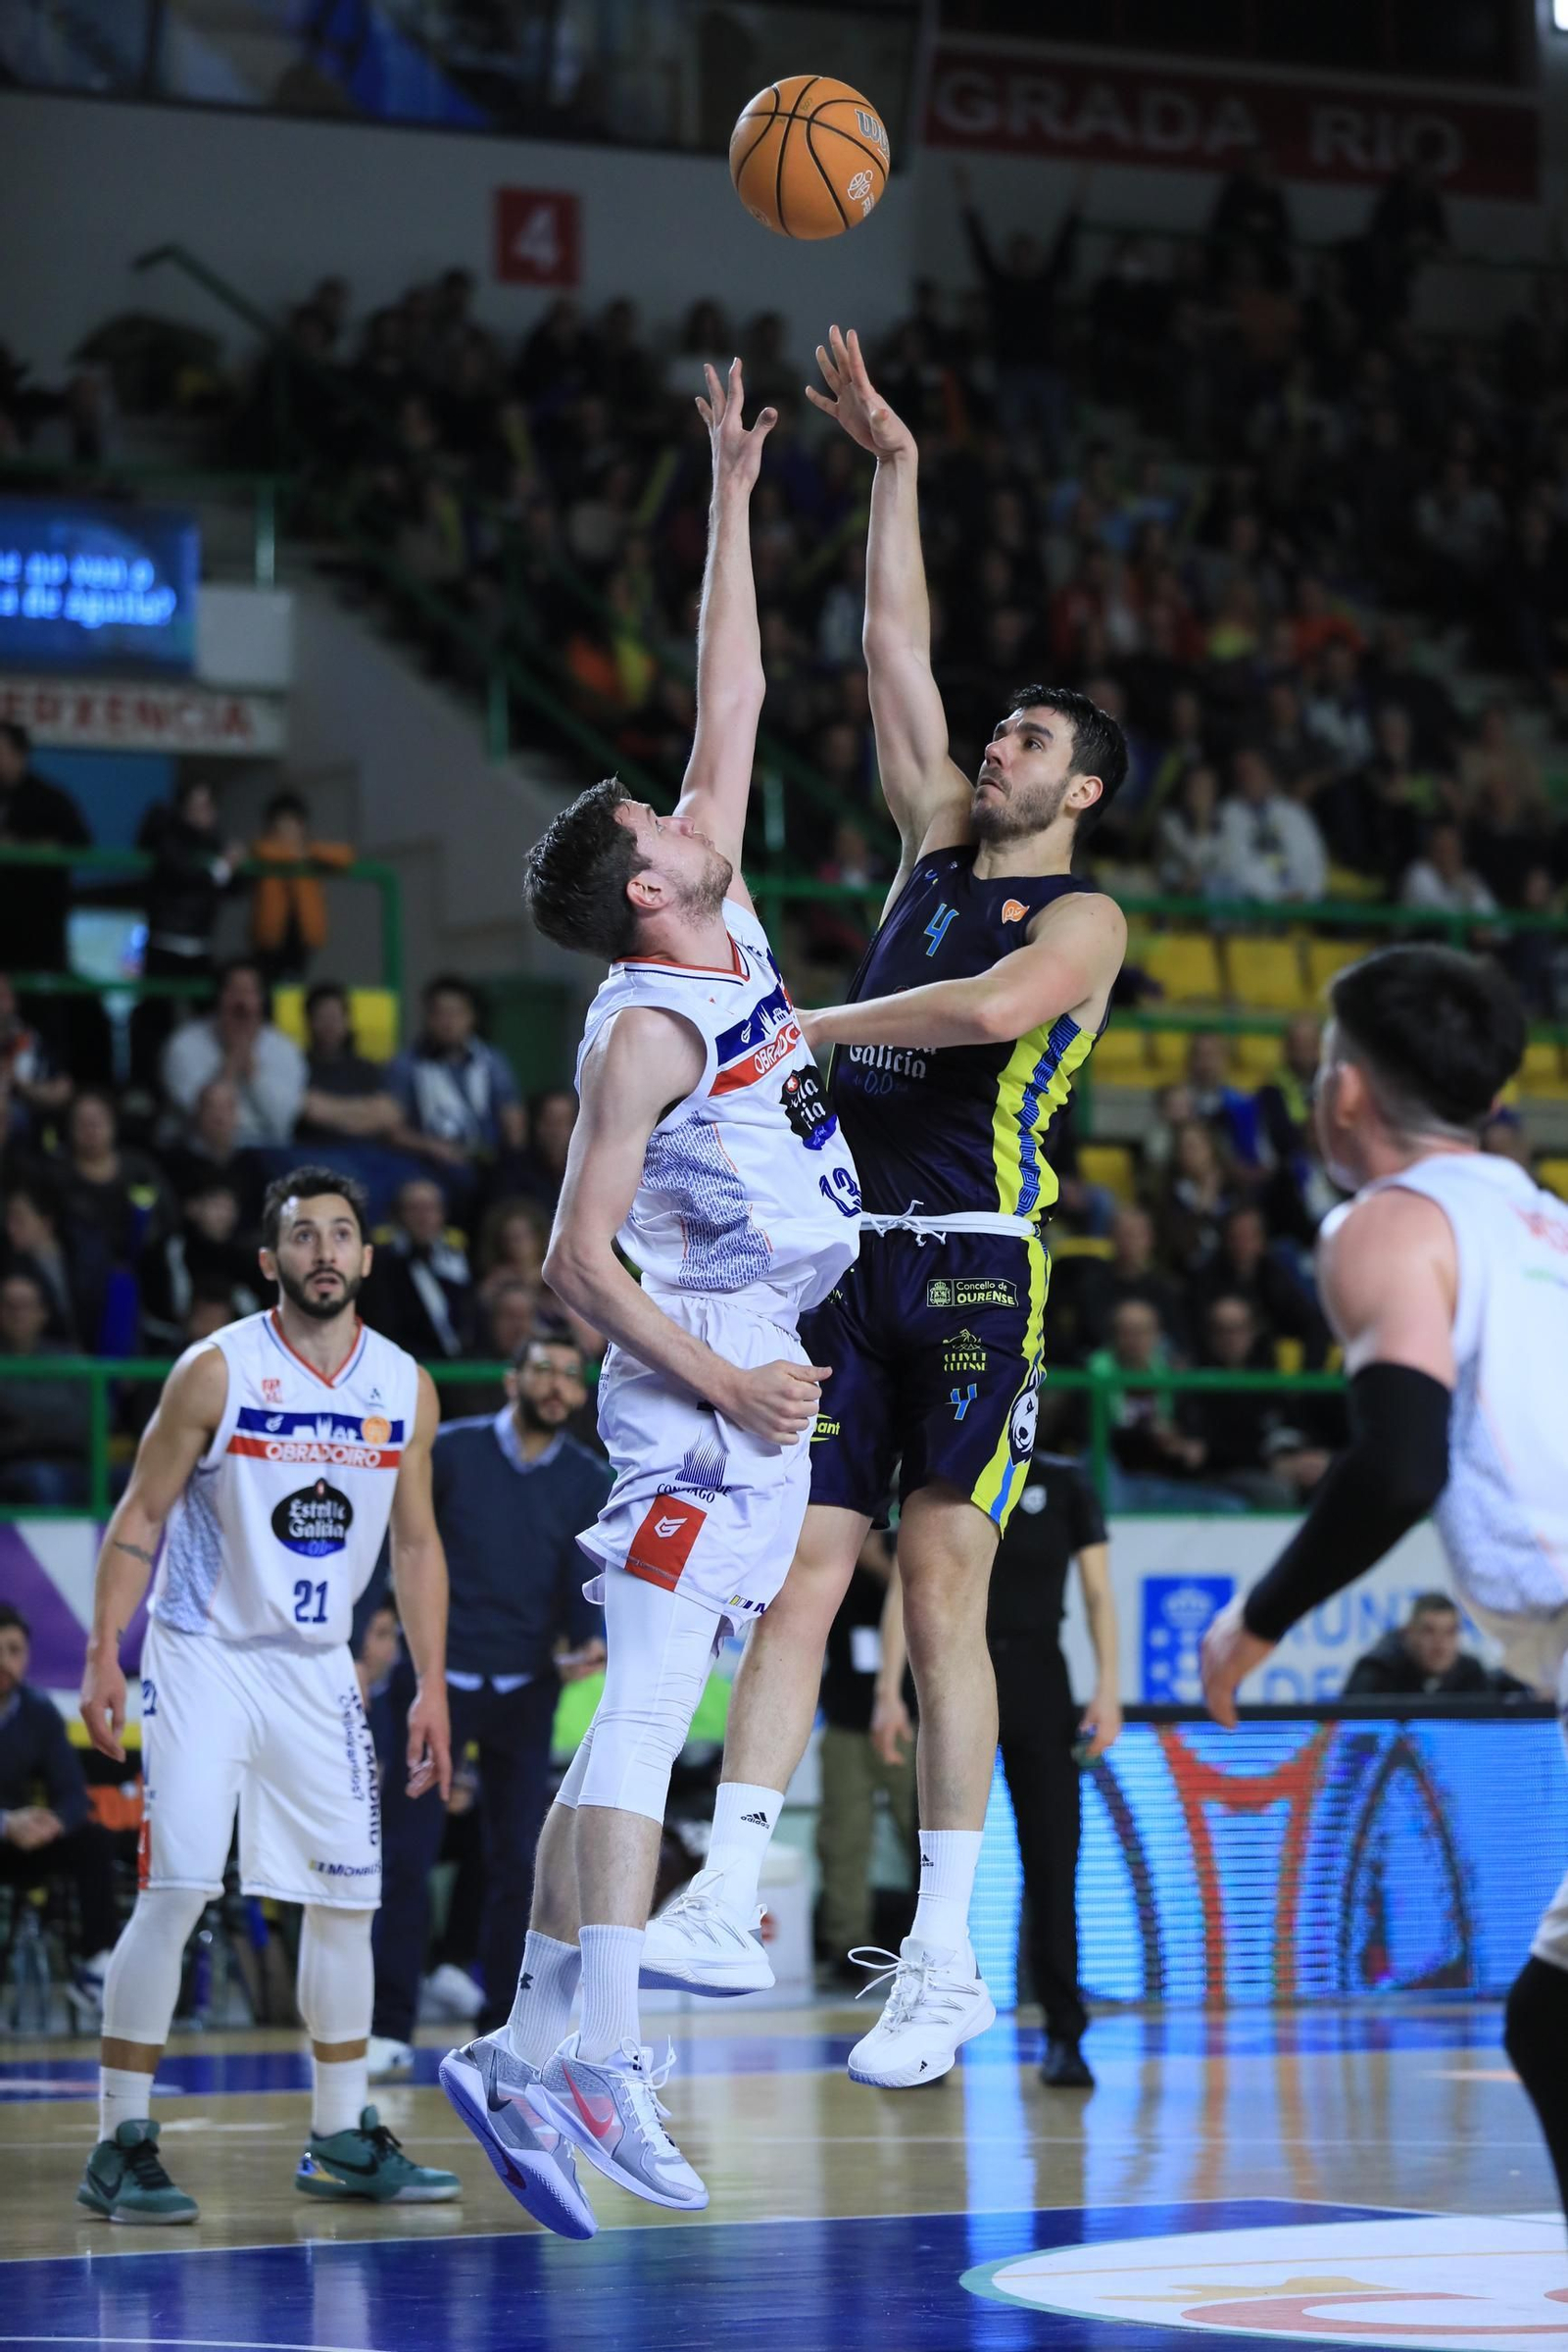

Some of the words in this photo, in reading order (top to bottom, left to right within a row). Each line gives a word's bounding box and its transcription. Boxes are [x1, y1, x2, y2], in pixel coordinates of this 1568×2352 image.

[933, 68, 1259, 155] GRADA
[1309, 105, 1463, 176] RIO
[514, 203, 559, 274] 4
[923, 903, 959, 957] 4
[849, 1044, 926, 1079] Galicia
[819, 1167, 862, 1217] 13
[956, 1281, 996, 1292] Concello
[998, 1281, 1007, 1292] de
[956, 1291, 1016, 1305] OURENSE
[949, 1383, 978, 1420] 4
[266, 1443, 381, 1468] OBRADOIRO
[288, 1519, 345, 1538] Galicia
[294, 1580, 327, 1623] 21
[740, 1816, 770, 1830] adidas
